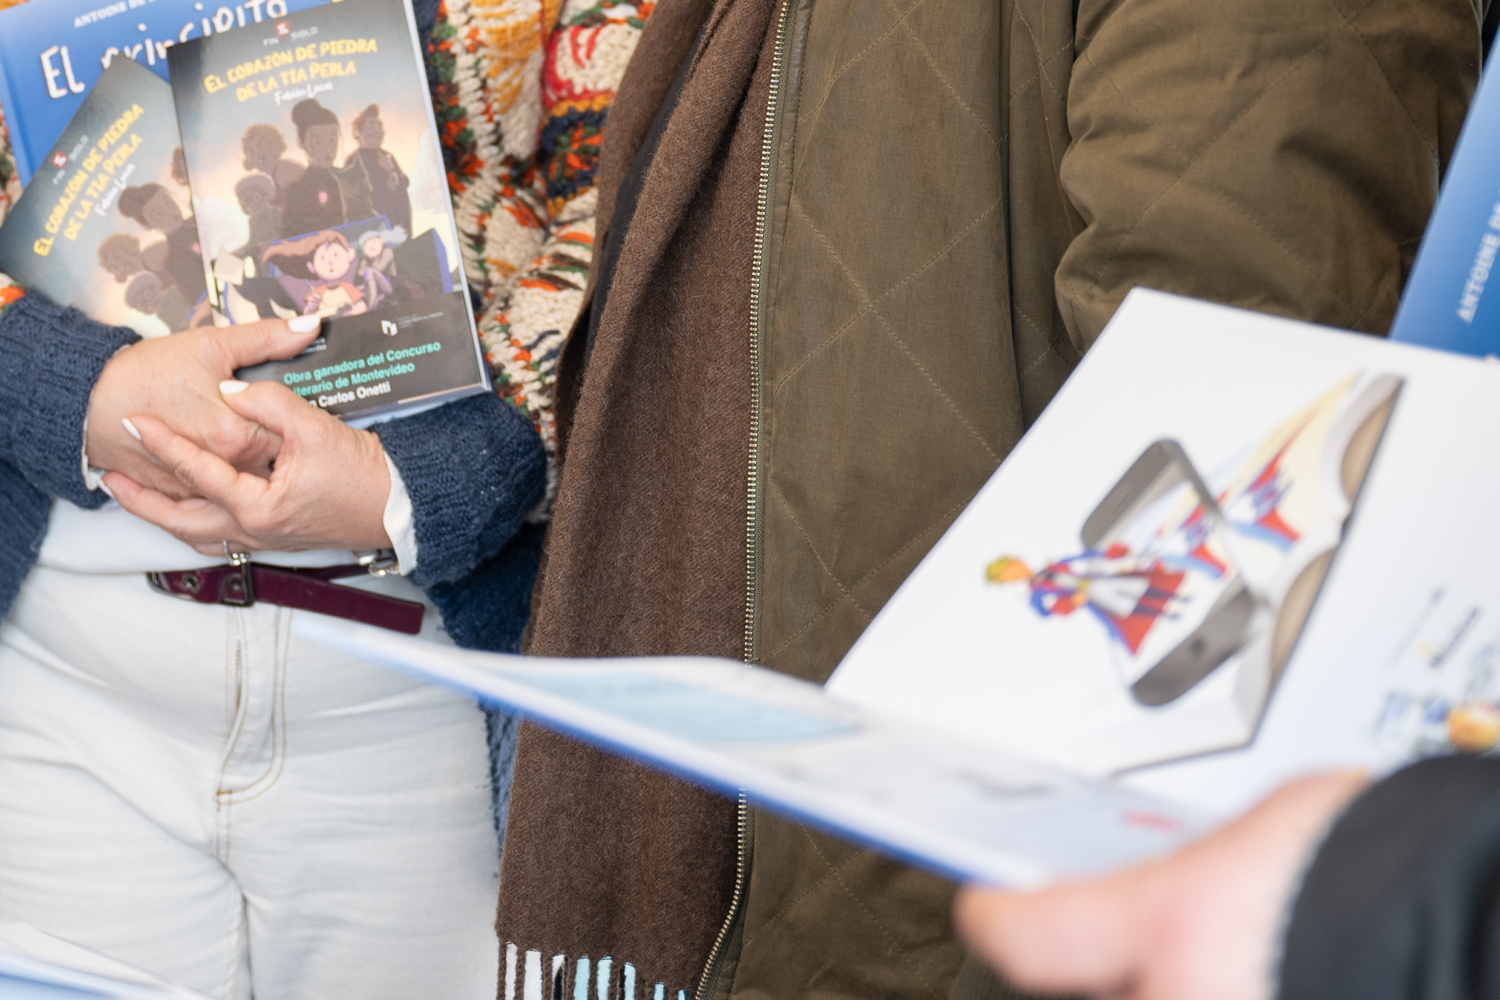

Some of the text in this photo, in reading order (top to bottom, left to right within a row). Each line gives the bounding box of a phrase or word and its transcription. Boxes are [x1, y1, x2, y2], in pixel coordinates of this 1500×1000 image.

[74, 1, 128, 28] ANTOINE
[203, 38, 378, 94] EL CORAZÓN DE PIEDRA
[235, 82, 258, 103] DE
[257, 76, 279, 94] LA
[82, 147, 103, 172] DE
[97, 102, 145, 153] PIEDRA
[63, 217, 83, 242] DE
[74, 199, 94, 220] LA
[283, 341, 442, 386] Obra ganadora del Concurso
[293, 361, 416, 398] iterario de Montevideo
[318, 389, 356, 408] Carlos
[356, 380, 392, 400] Onetti
